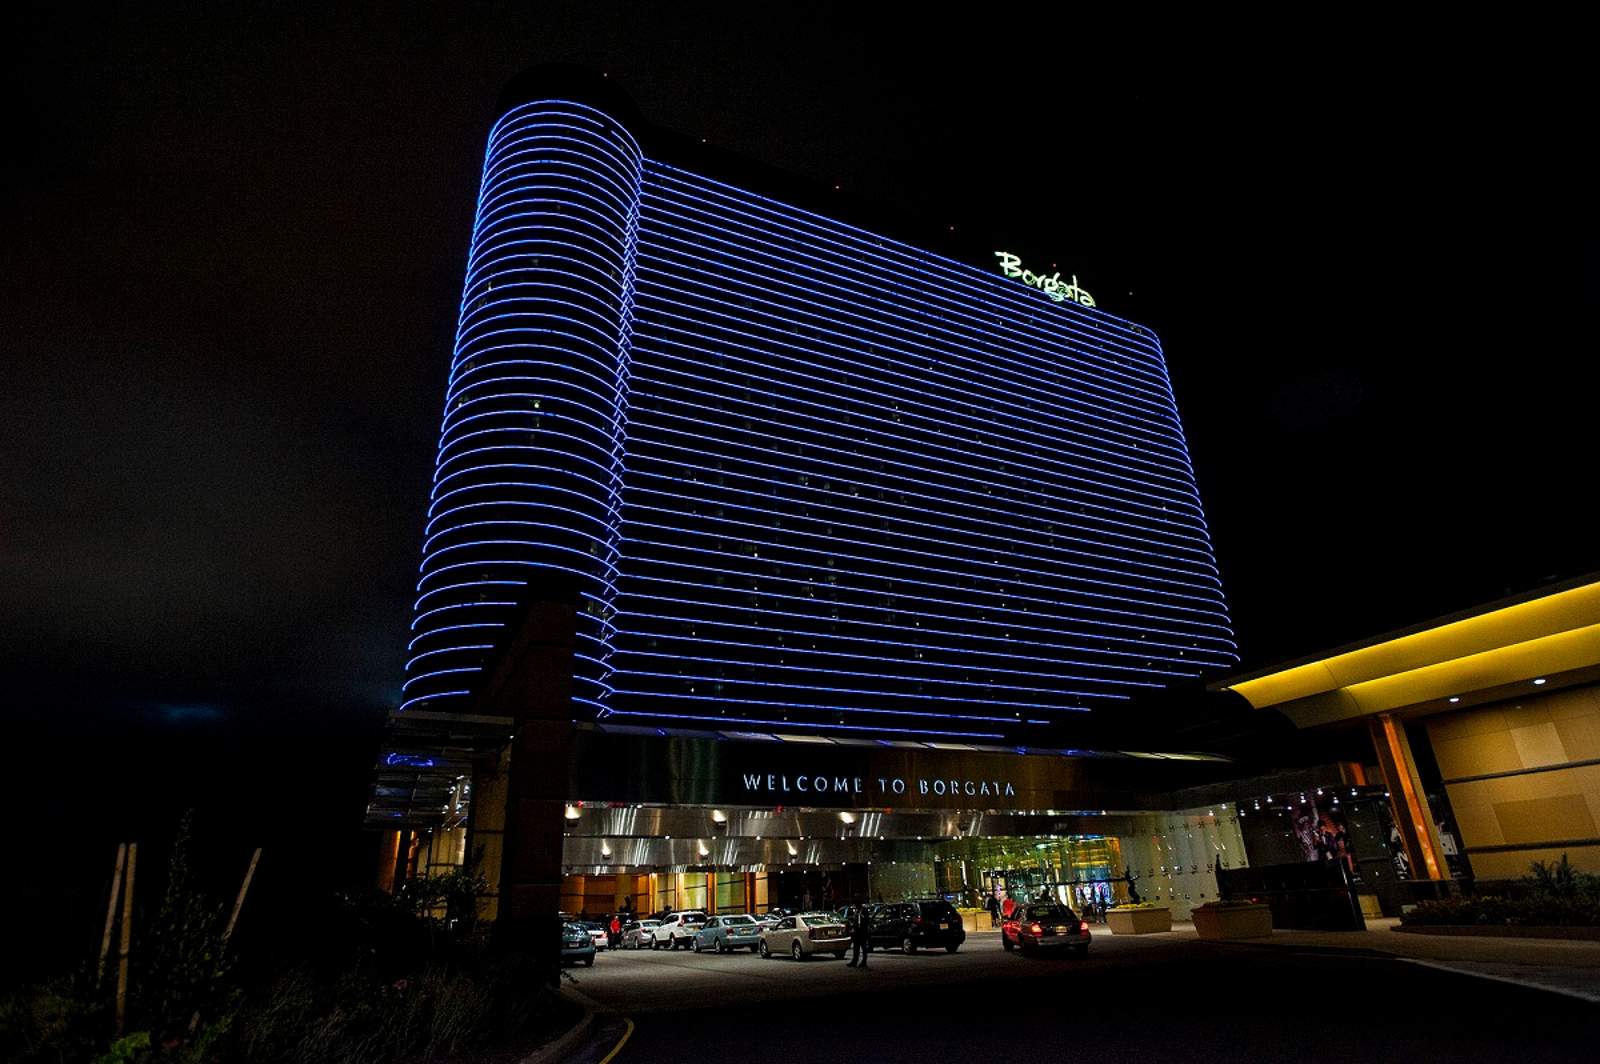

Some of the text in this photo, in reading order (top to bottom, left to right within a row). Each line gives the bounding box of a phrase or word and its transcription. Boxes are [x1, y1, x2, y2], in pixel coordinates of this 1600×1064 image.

[994, 251, 1097, 308] Borgata
[743, 774, 1015, 796] WELCOME TO BORGATA
